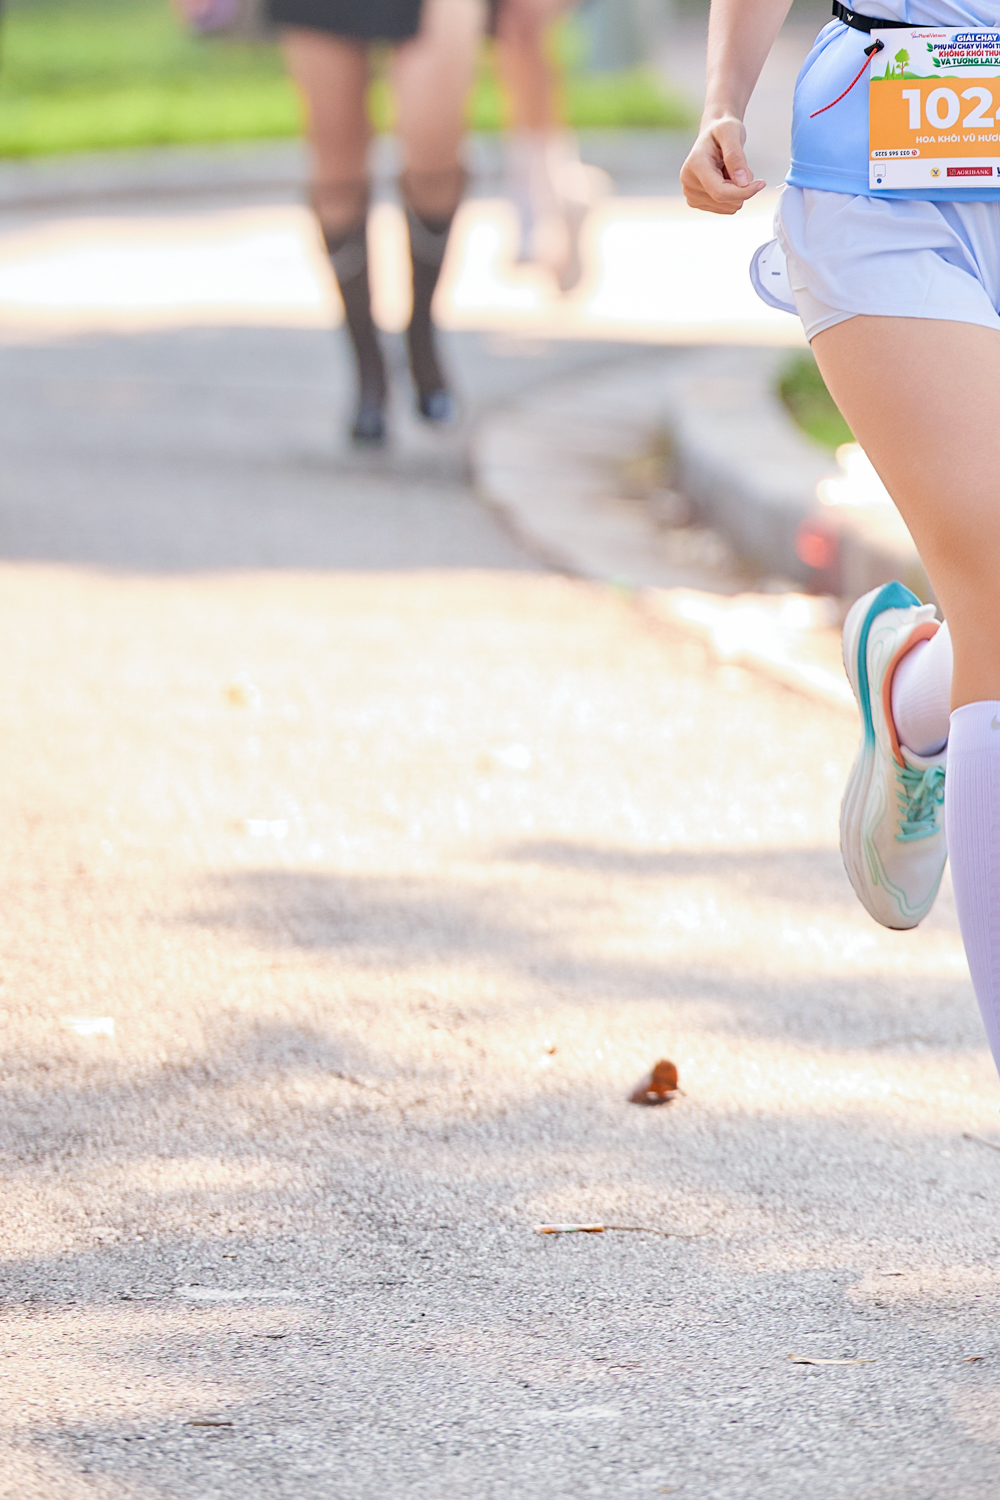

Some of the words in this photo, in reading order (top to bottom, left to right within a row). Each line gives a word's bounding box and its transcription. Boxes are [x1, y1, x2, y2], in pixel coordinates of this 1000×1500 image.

[956, 32, 975, 41] GIẢI
[975, 34, 998, 42] CHẠY
[940, 57, 951, 65] VÀ
[938, 134, 960, 142] KHÔI
[962, 133, 975, 142] VŨ
